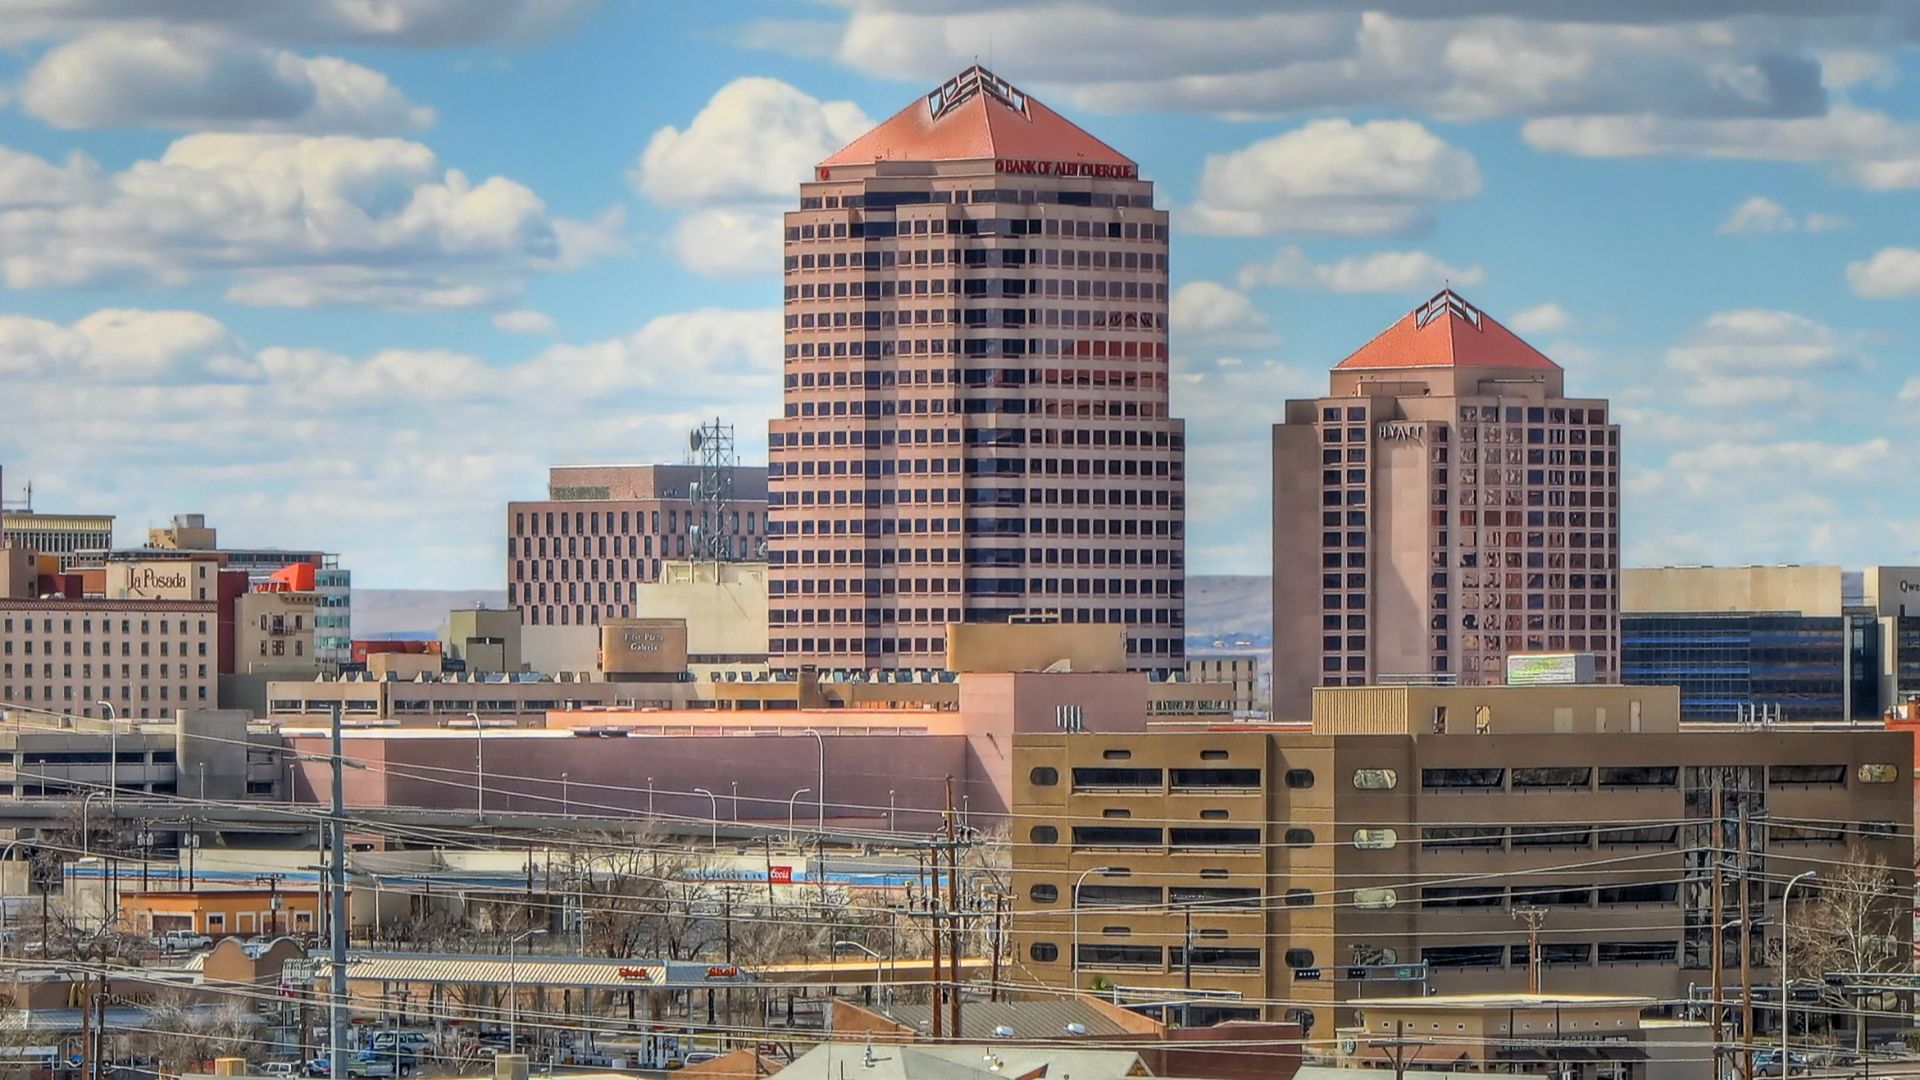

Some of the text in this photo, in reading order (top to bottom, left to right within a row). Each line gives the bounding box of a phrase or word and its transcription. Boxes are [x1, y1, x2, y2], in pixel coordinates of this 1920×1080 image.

[1005, 159, 1037, 174] BANK
[1038, 160, 1052, 175] OF
[1378, 425, 1423, 440] HYATT
[144, 567, 186, 588] Posada
